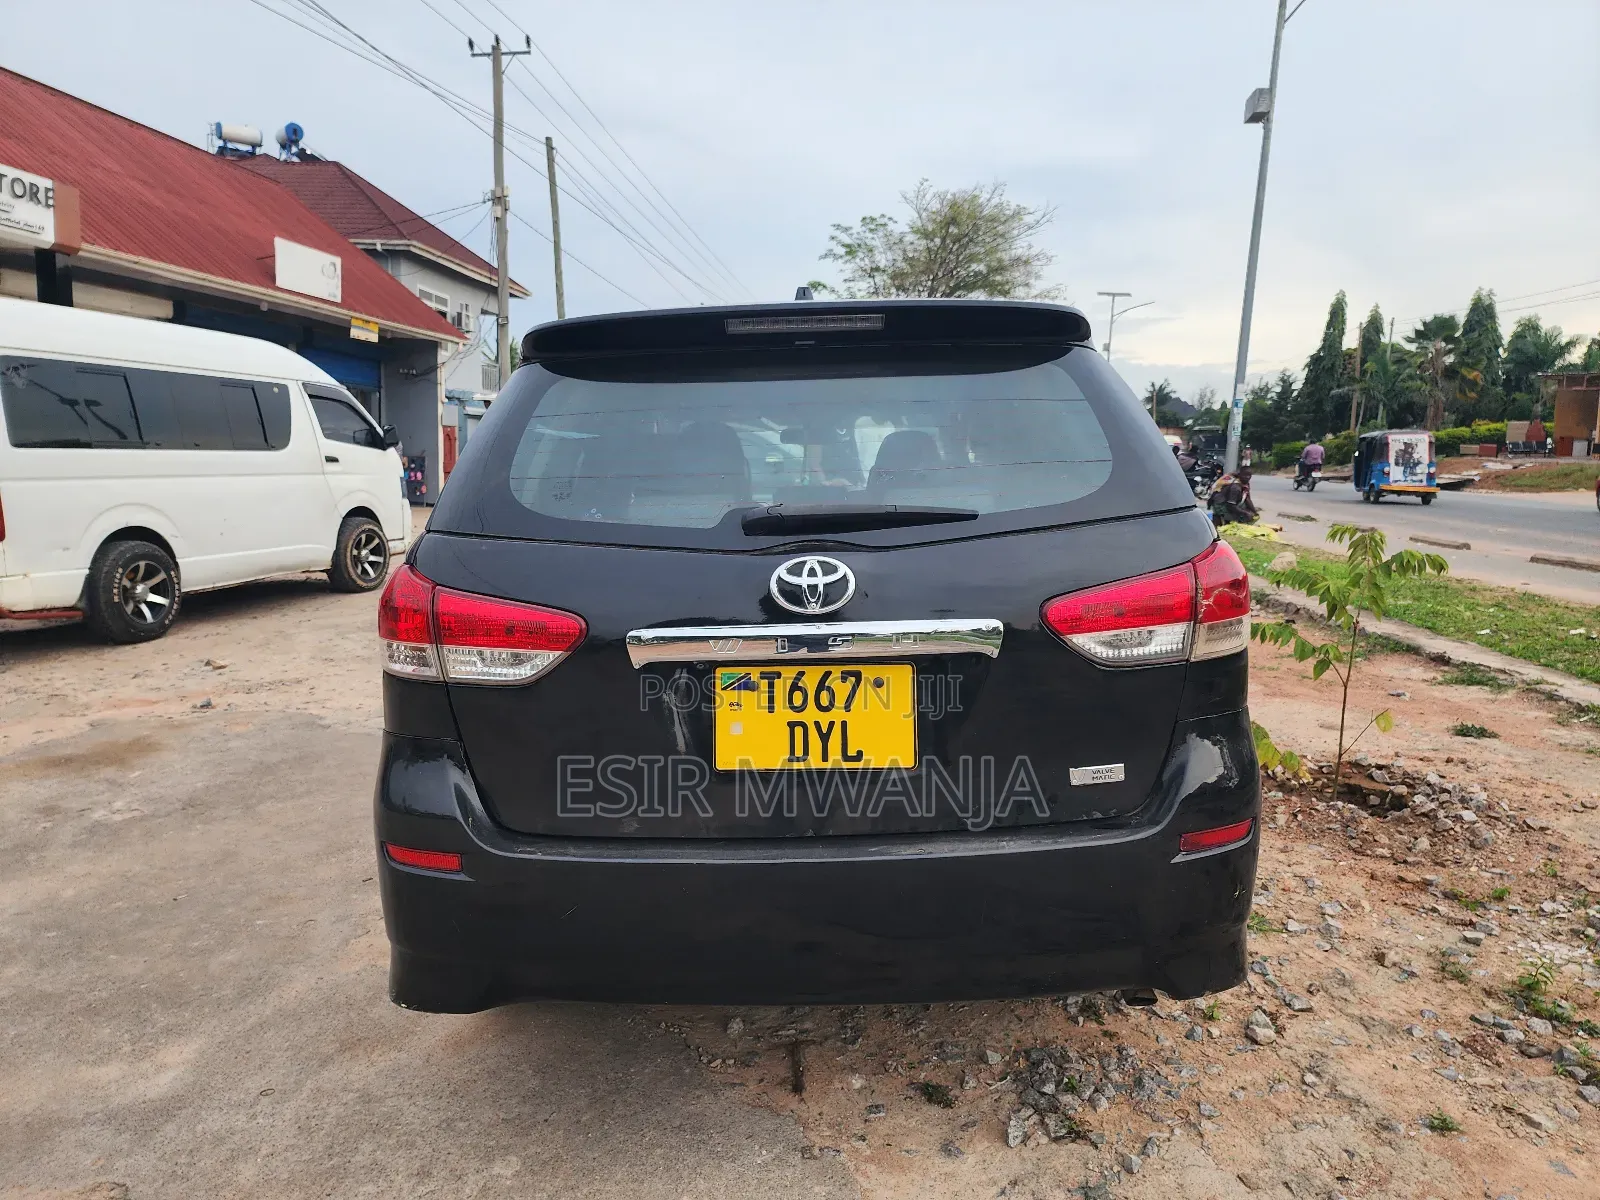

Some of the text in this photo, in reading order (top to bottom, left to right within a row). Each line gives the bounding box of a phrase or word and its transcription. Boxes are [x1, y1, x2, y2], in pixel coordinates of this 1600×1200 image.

[708, 633, 920, 654] WISH
[759, 670, 863, 713] T667
[786, 720, 864, 763] DYL
[1091, 767, 1115, 775] VALVE
